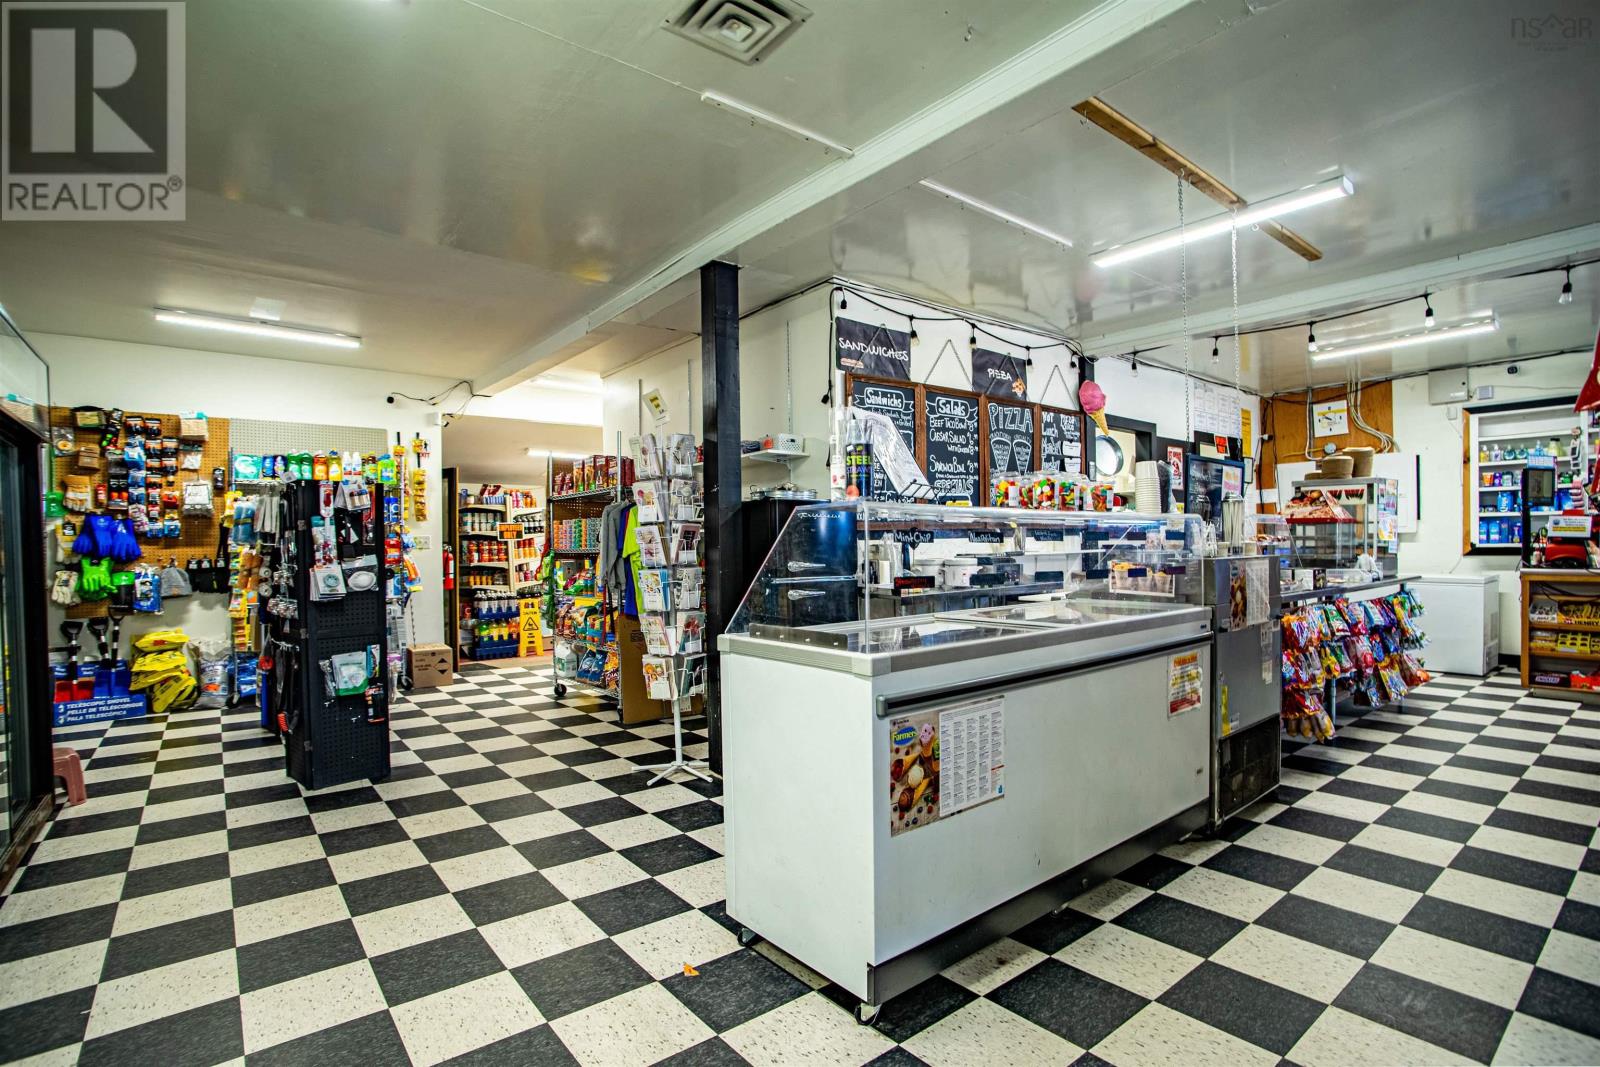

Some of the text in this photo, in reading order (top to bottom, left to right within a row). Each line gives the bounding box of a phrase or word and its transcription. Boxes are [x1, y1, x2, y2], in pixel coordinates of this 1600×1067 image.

[838, 336, 910, 362] SANDWICHES
[939, 399, 966, 416] Salads
[988, 402, 1034, 433] PIZZA
